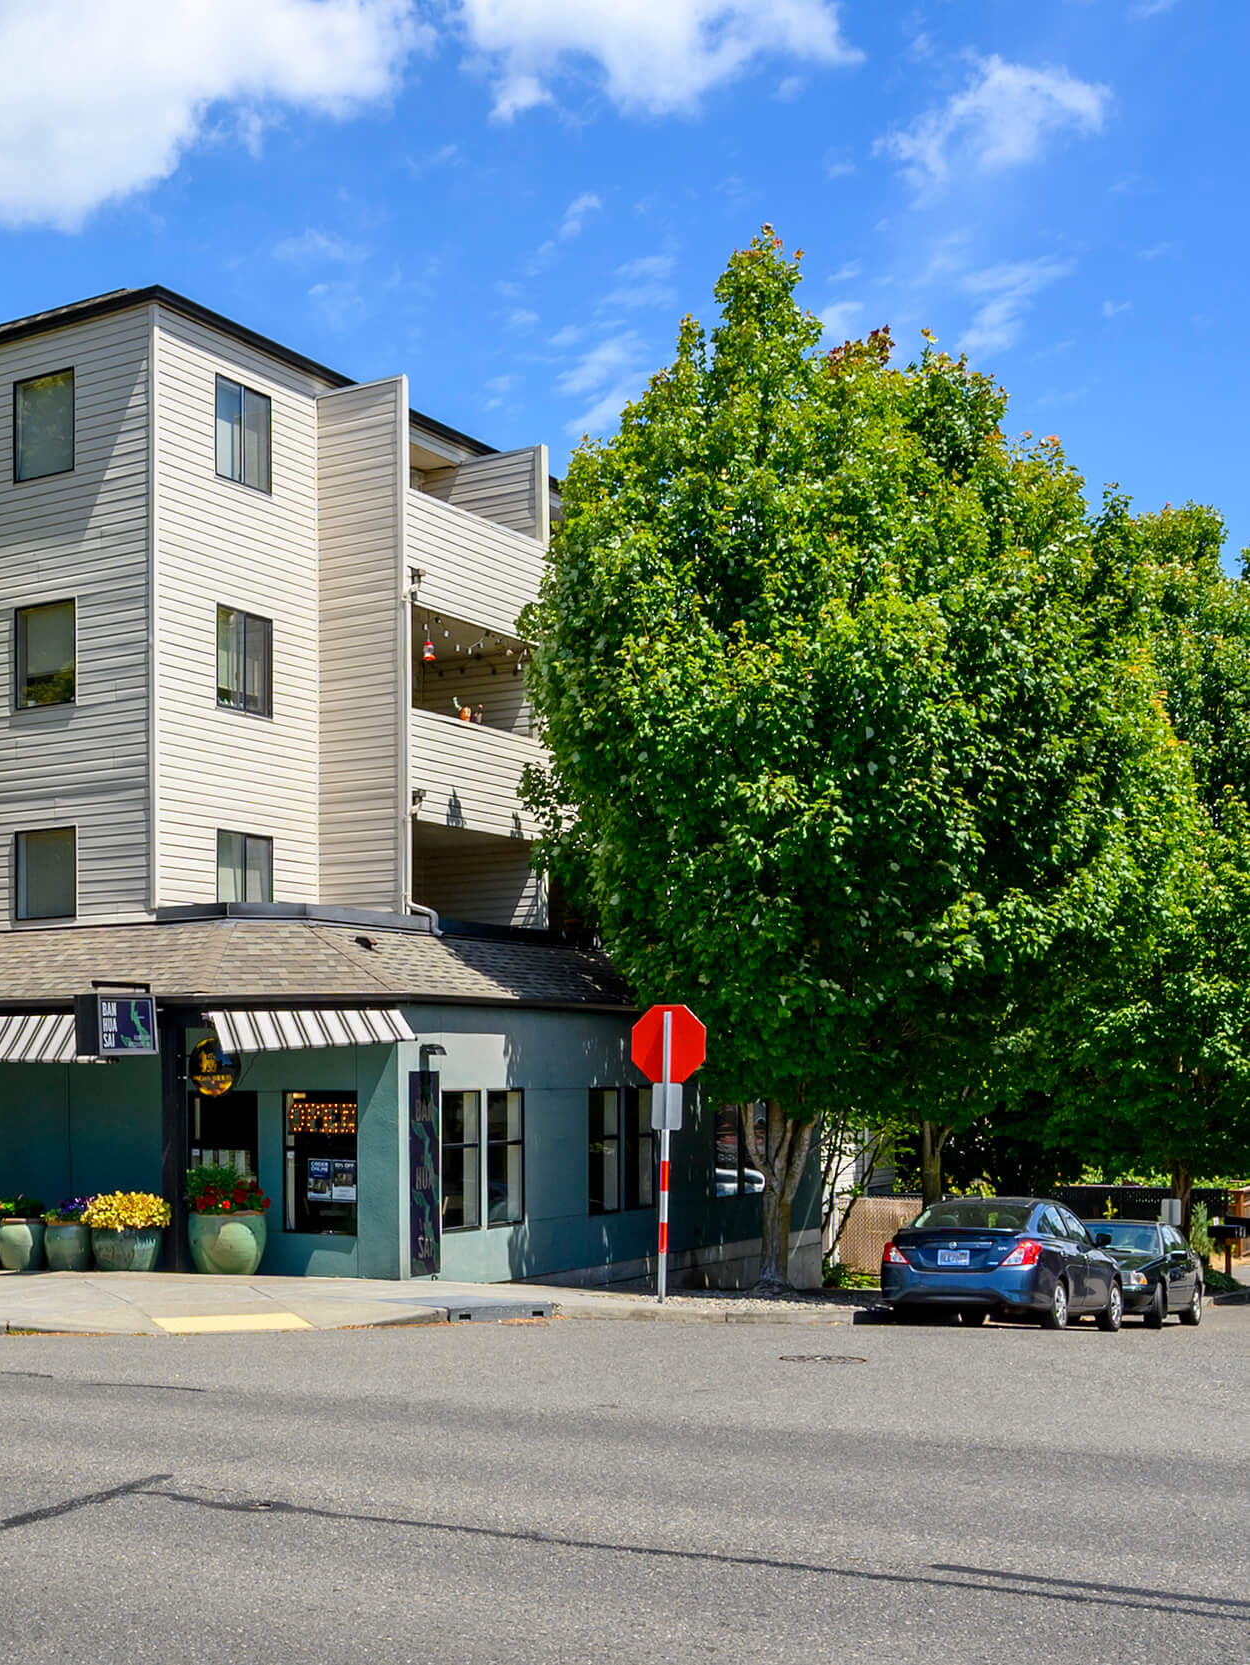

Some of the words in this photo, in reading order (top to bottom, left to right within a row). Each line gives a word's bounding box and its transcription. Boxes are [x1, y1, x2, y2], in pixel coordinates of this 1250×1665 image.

[102, 1002, 117, 1017] BAN
[103, 1017, 118, 1033] HUA
[103, 1033, 116, 1048] SAI
[289, 1103, 357, 1133] OPEN
[415, 1101, 433, 1122] BAN
[415, 1167, 433, 1190] HUA
[418, 1236, 433, 1258] SAI
